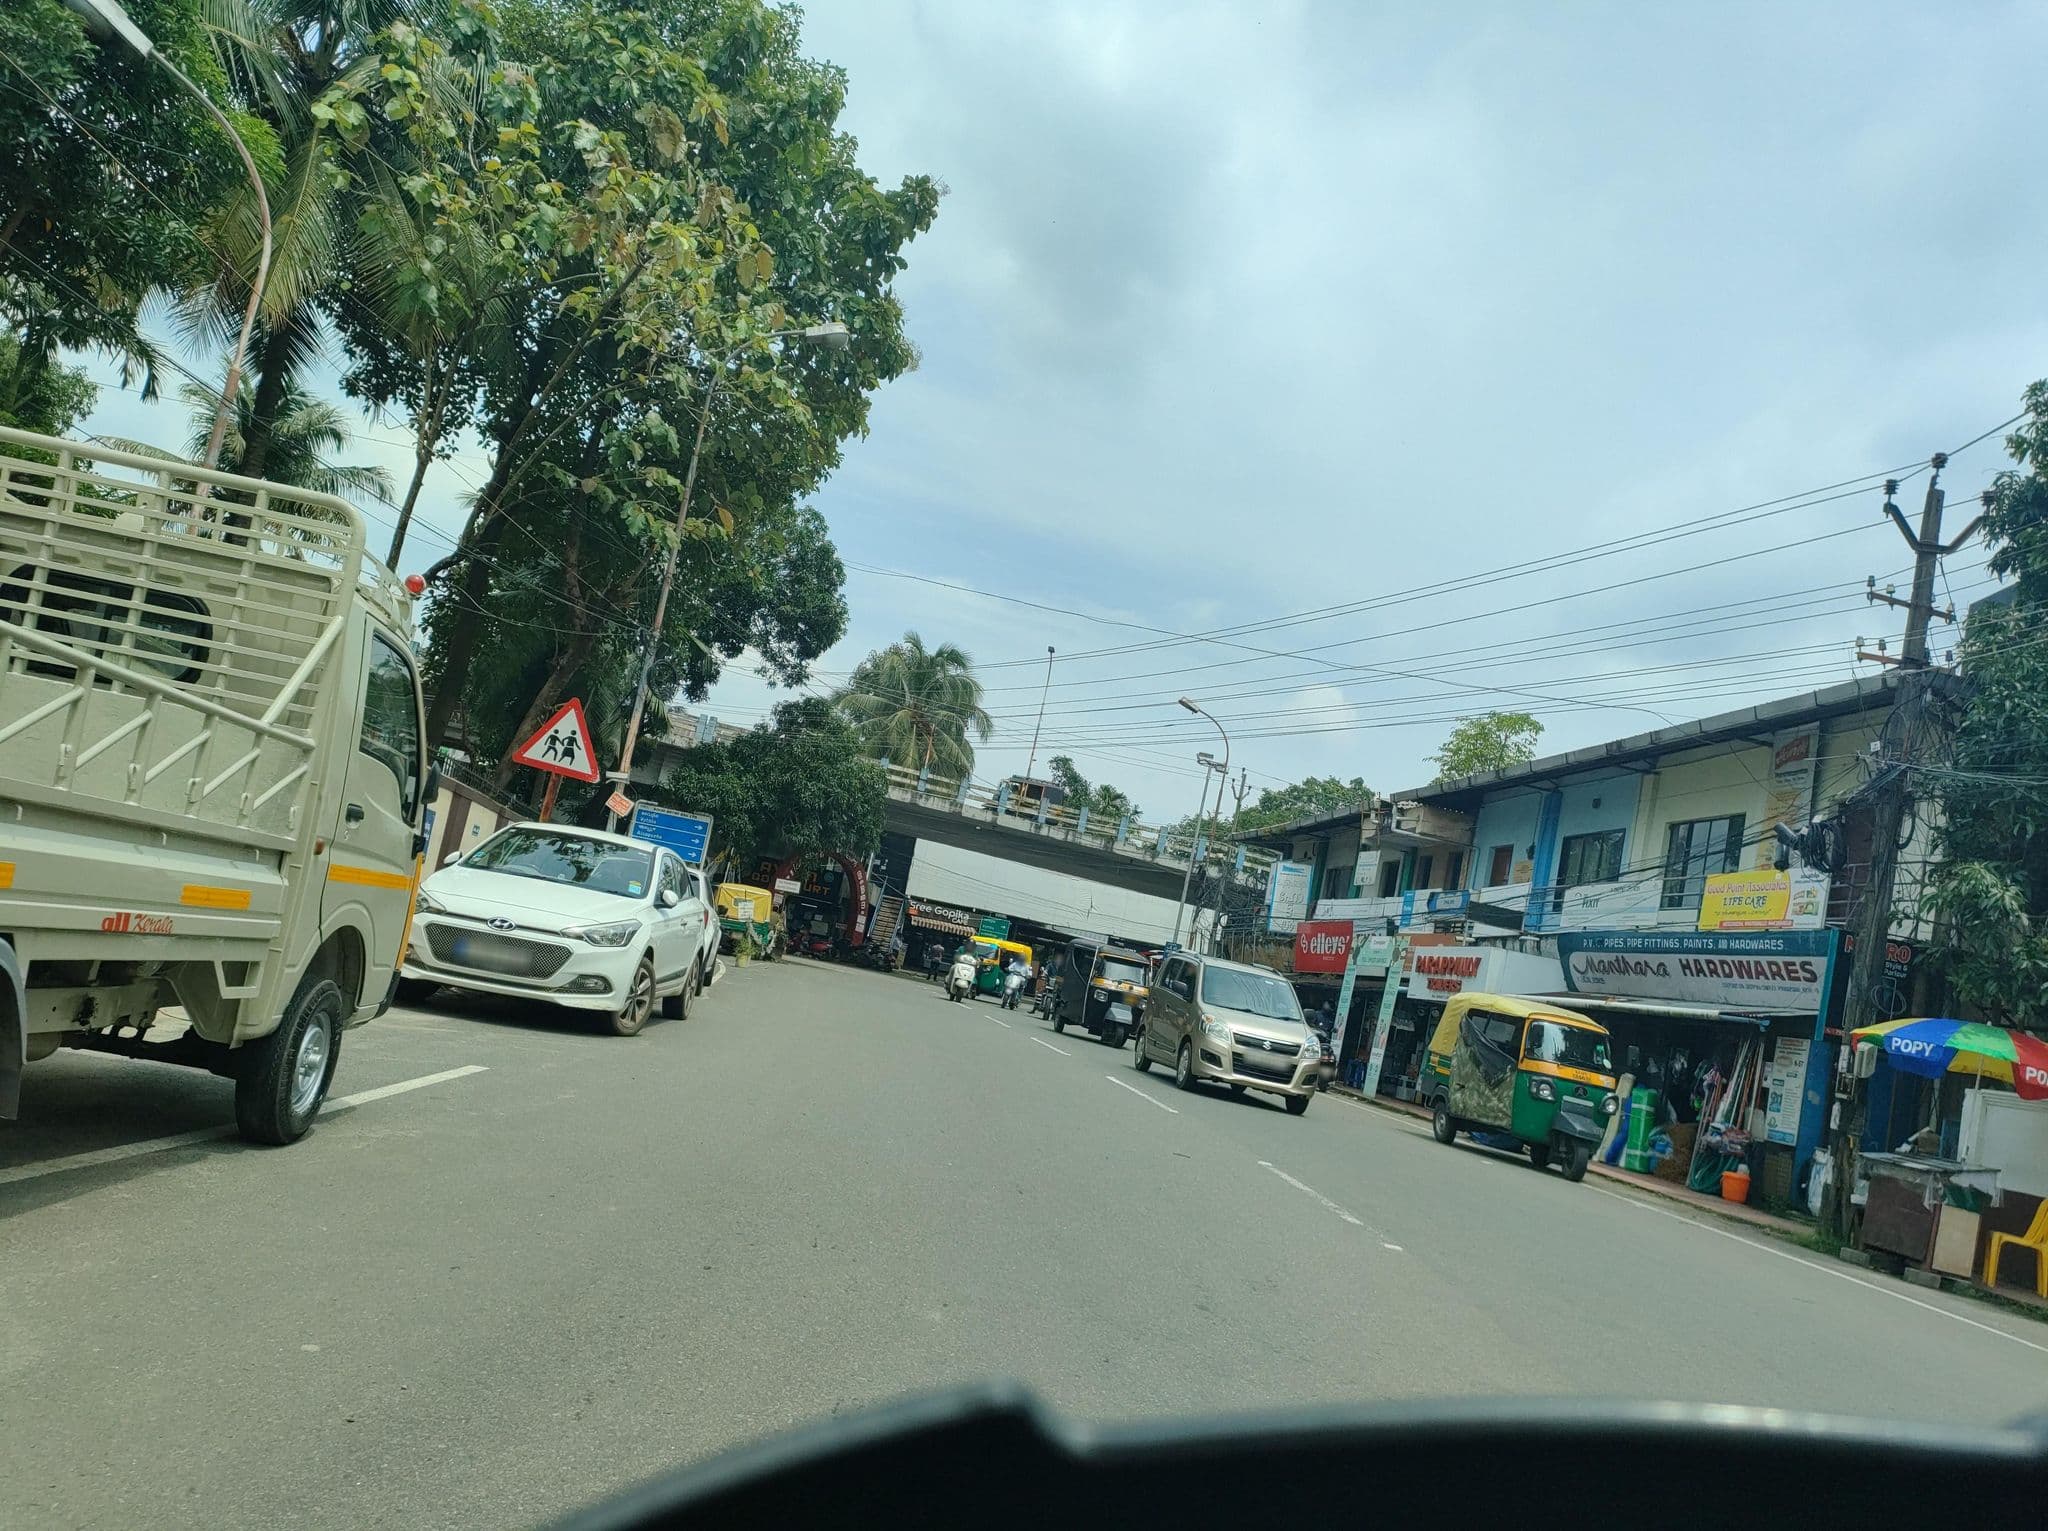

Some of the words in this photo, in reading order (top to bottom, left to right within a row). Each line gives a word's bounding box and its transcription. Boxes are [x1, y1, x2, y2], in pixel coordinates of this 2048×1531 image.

[910, 901, 932, 913] Sree
[934, 906, 970, 921] Gopika
[1723, 895, 1743, 906] LIFE
[1744, 895, 1768, 909] CARE
[101, 911, 131, 933] all
[133, 913, 173, 935] Kerala
[1627, 938, 1643, 949] PIPE
[1729, 940, 1784, 951] HARDWARES
[1678, 958, 1818, 983] HARDWARES
[1891, 1037, 1935, 1057] POPY
